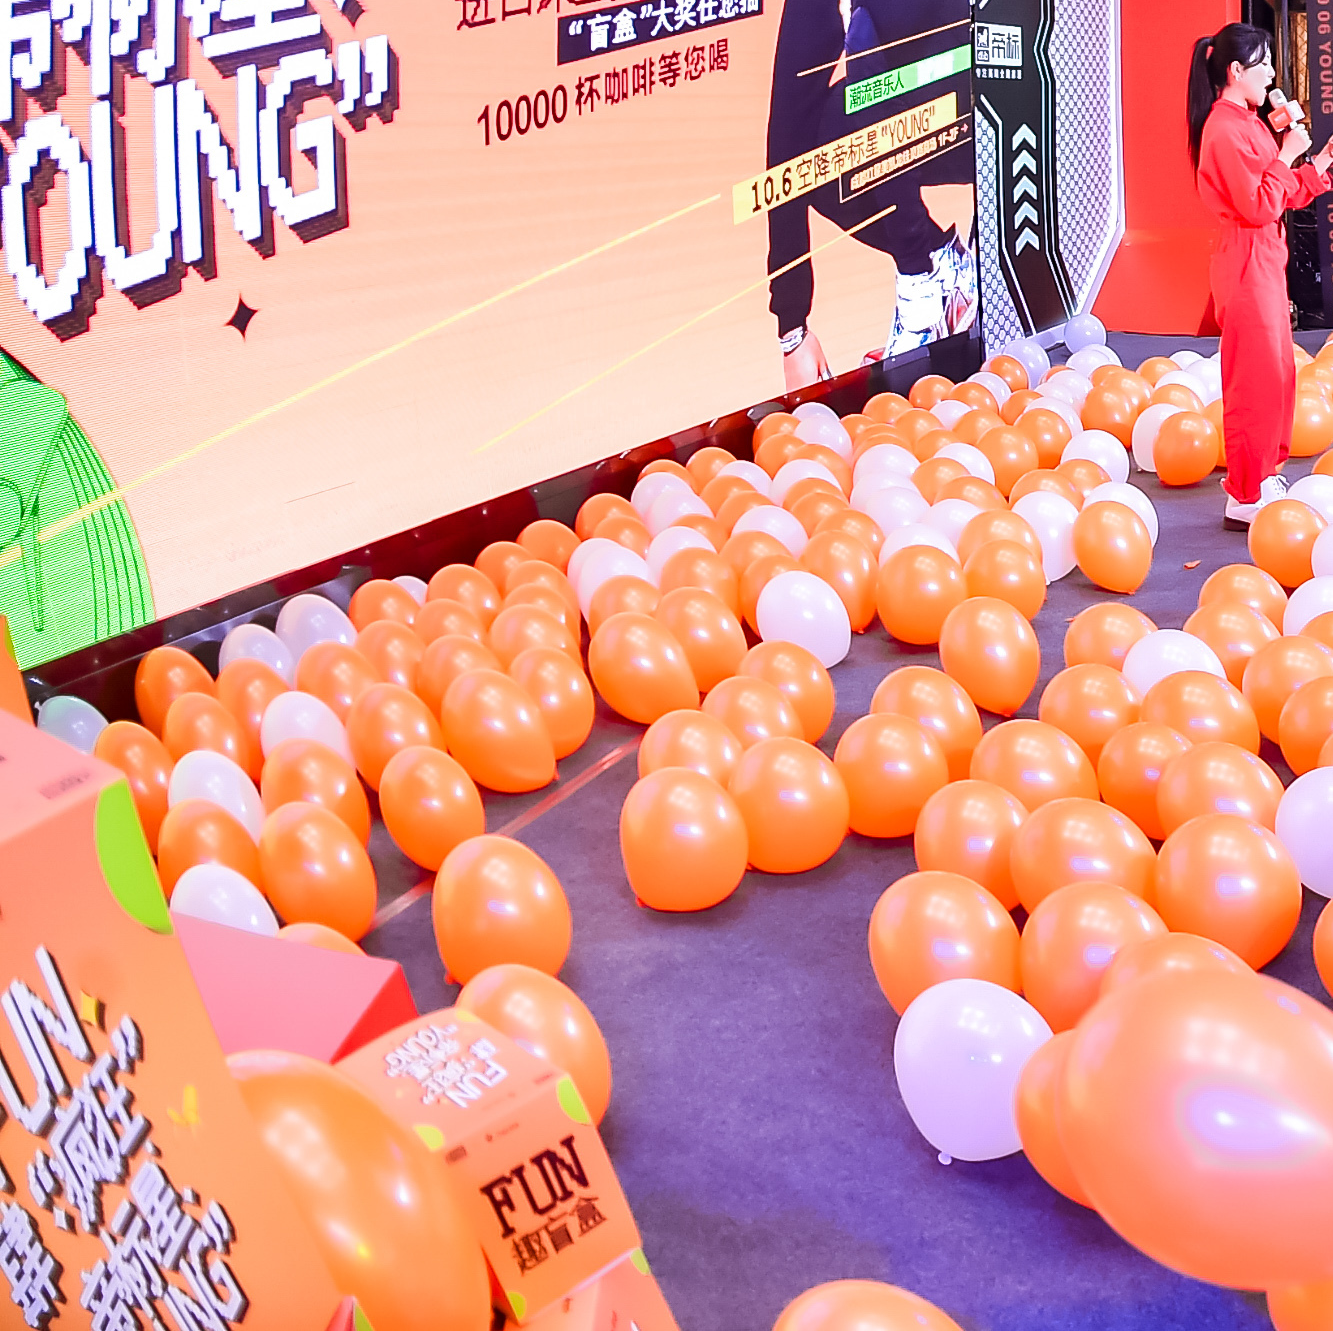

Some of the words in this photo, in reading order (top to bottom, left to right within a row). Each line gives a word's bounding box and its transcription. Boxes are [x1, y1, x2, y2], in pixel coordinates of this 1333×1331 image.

[991, 31, 1020, 60] 帝标
[1317, 10, 1332, 35] 06
[476, 83, 569, 146] 10000
[574, 37, 730, 116] 杯咖啡等您喝
[3, 35, 388, 324] OUNG”
[750, 166, 793, 214] 10.6
[0, 945, 92, 1135] UN
[445, 1059, 508, 1109] FUN
[479, 1134, 591, 1240] FUN
